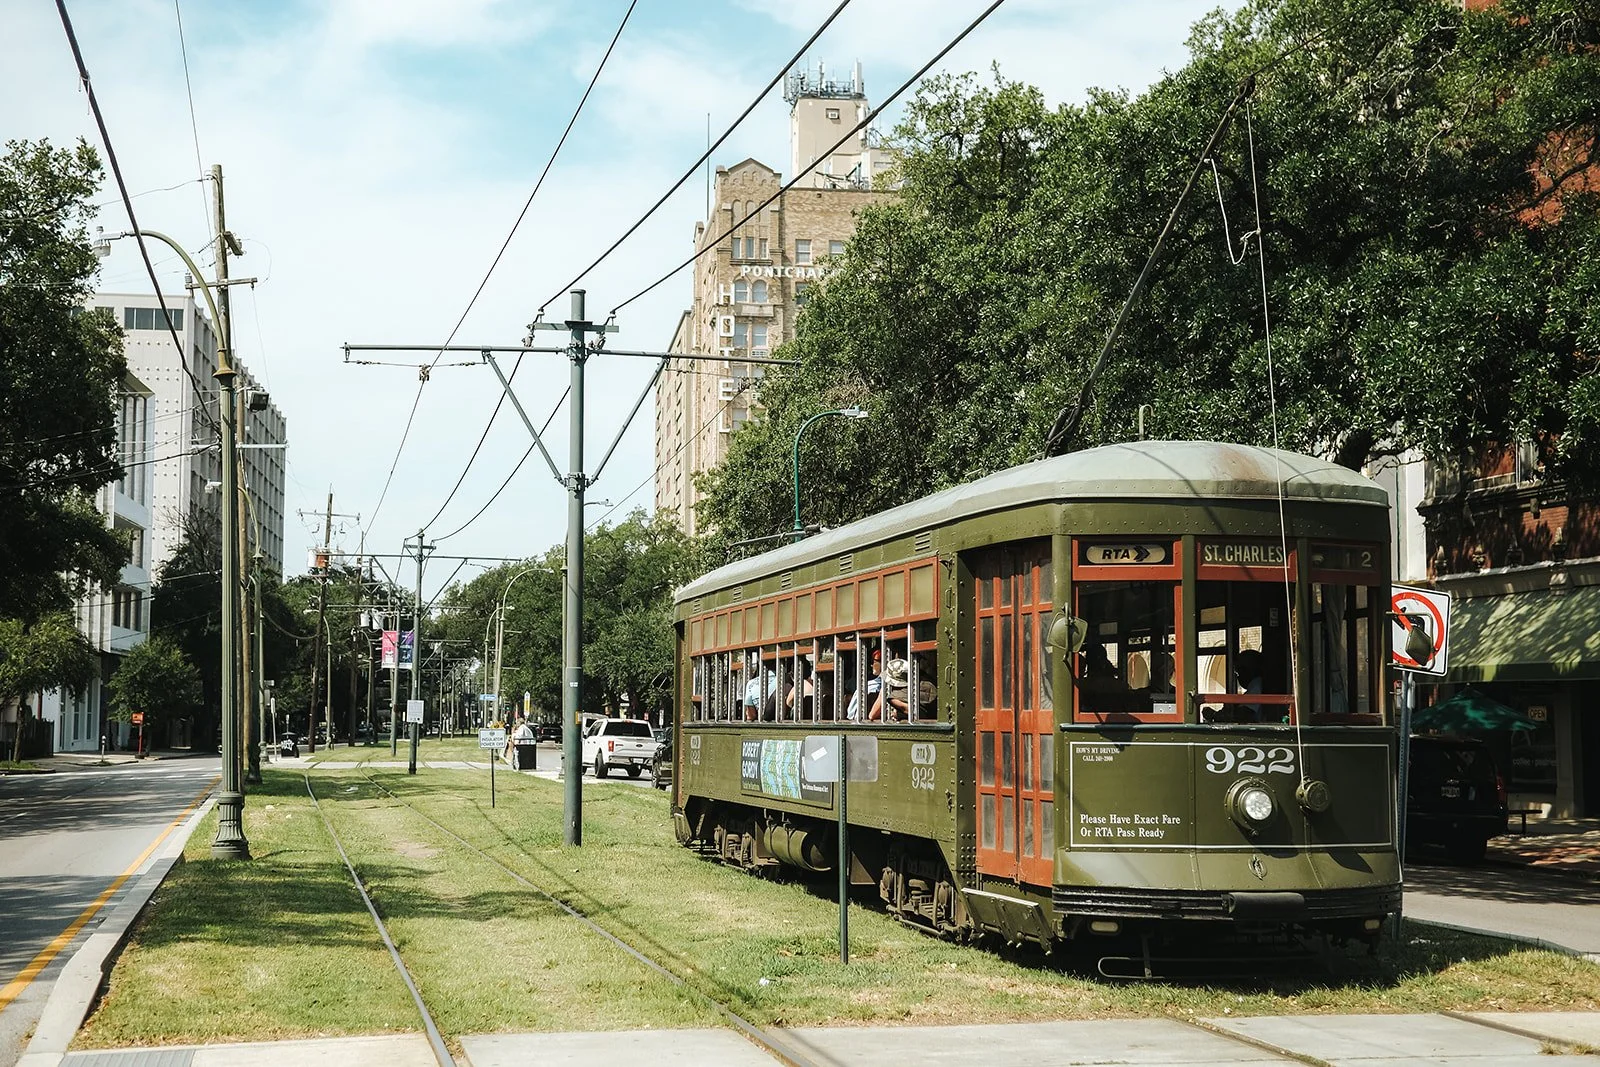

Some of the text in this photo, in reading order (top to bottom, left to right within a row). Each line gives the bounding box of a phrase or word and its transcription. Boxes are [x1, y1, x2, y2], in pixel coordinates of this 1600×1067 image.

[718, 283, 735, 433] HOTEL
[1101, 549, 1131, 560] RTA
[1204, 545, 1284, 563] ST. CHARLES
[1530, 709, 1545, 718] OPEN
[1205, 747, 1295, 774] 922
[911, 767, 935, 791] 922
[1080, 814, 1181, 825] Please Have Exact Fare
[1080, 827, 1165, 840] Or RTA Pass Ready
